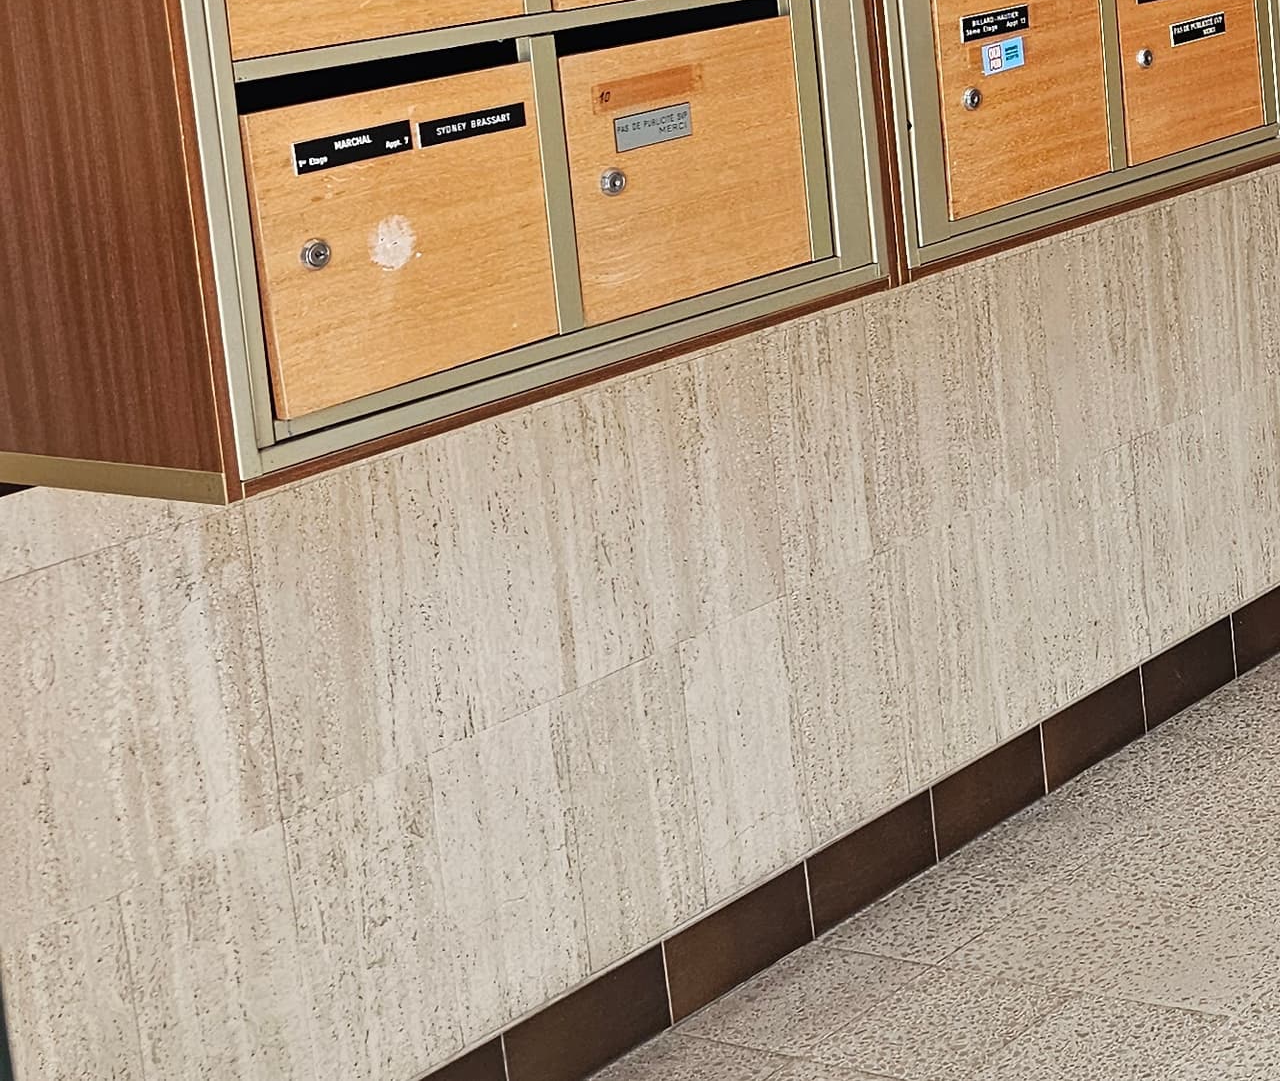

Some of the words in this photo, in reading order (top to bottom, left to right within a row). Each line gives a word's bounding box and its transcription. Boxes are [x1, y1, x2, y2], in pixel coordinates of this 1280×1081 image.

[436, 122, 467, 137] SYDNEY
[470, 112, 511, 129] BRASSART
[659, 121, 688, 134] MERCI
[333, 134, 373, 151] MARCHAL
